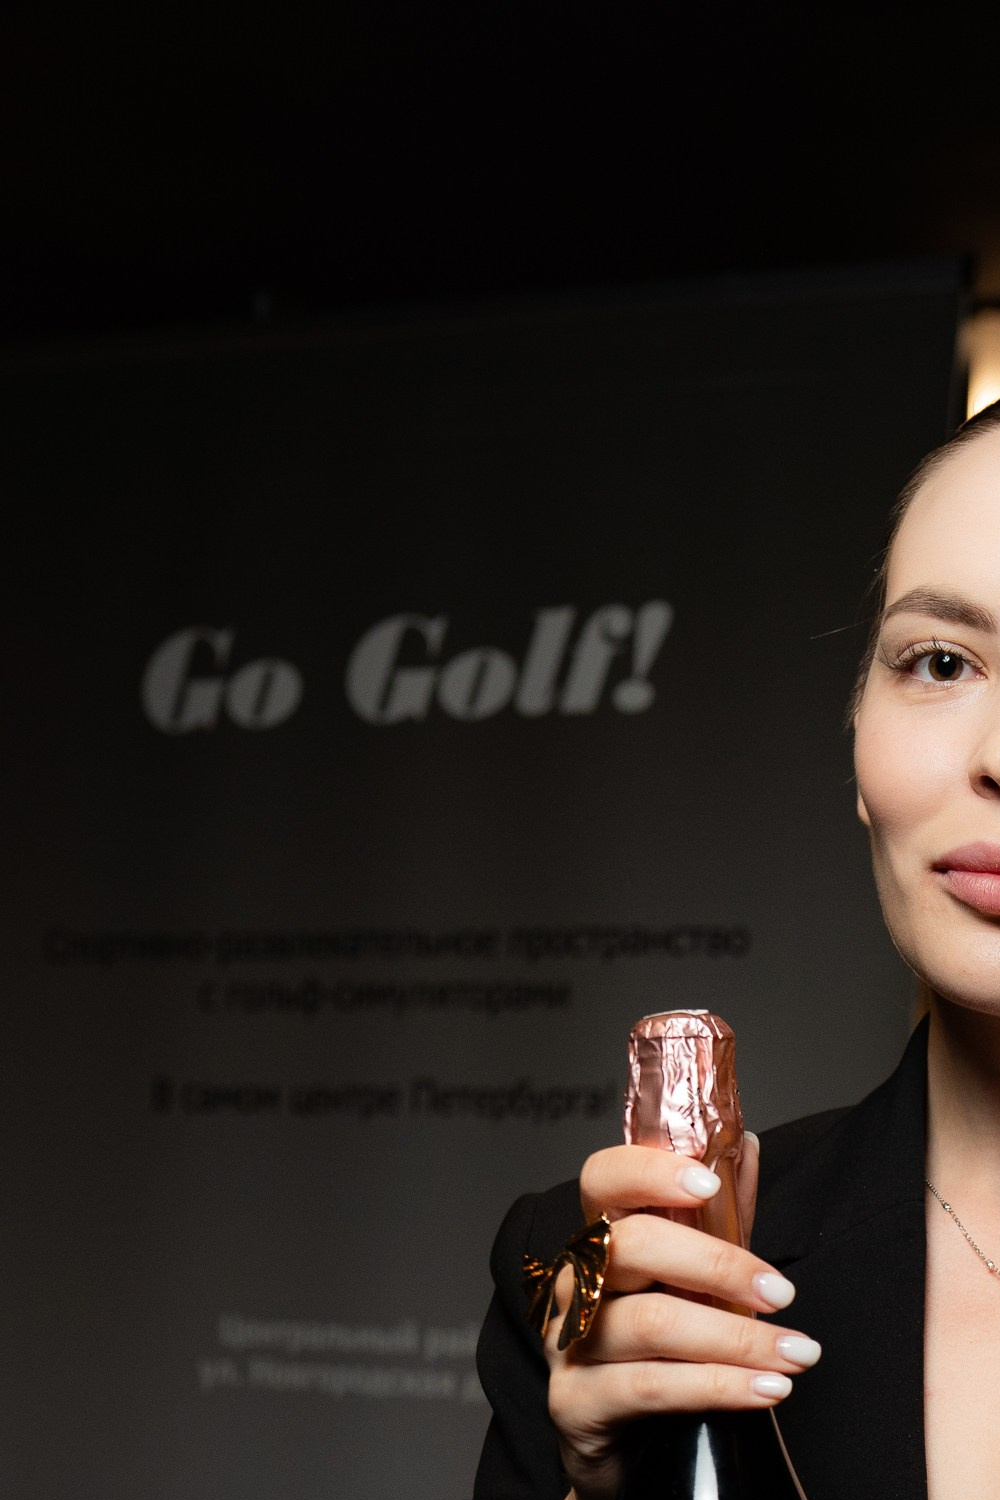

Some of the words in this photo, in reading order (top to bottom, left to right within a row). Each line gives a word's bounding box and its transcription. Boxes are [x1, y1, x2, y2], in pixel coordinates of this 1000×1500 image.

[142, 625, 303, 735] Go
[345, 600, 673, 727] Golf!
[506, 923, 750, 962] пространство
